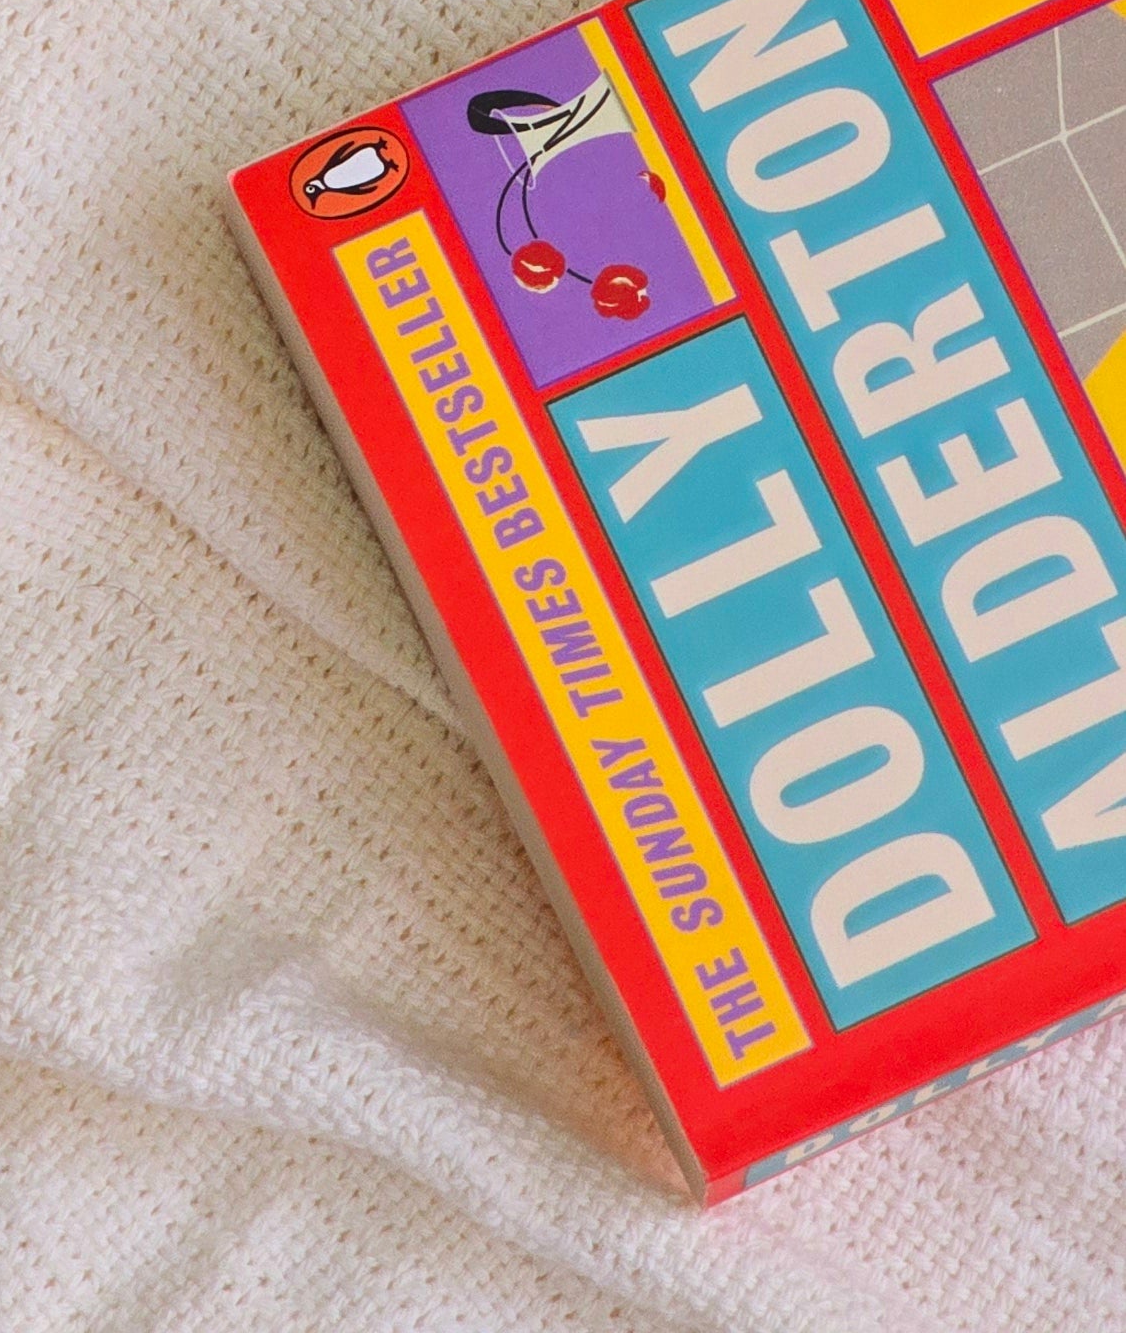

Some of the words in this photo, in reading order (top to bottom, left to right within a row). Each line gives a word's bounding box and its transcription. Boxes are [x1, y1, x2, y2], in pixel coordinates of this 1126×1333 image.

[365, 235, 547, 549] BESTSELLER
[512, 558, 624, 719] TIMES
[575, 381, 996, 990] DOLLY
[591, 736, 725, 933] SUNDAY
[699, 946, 778, 1061] THE
